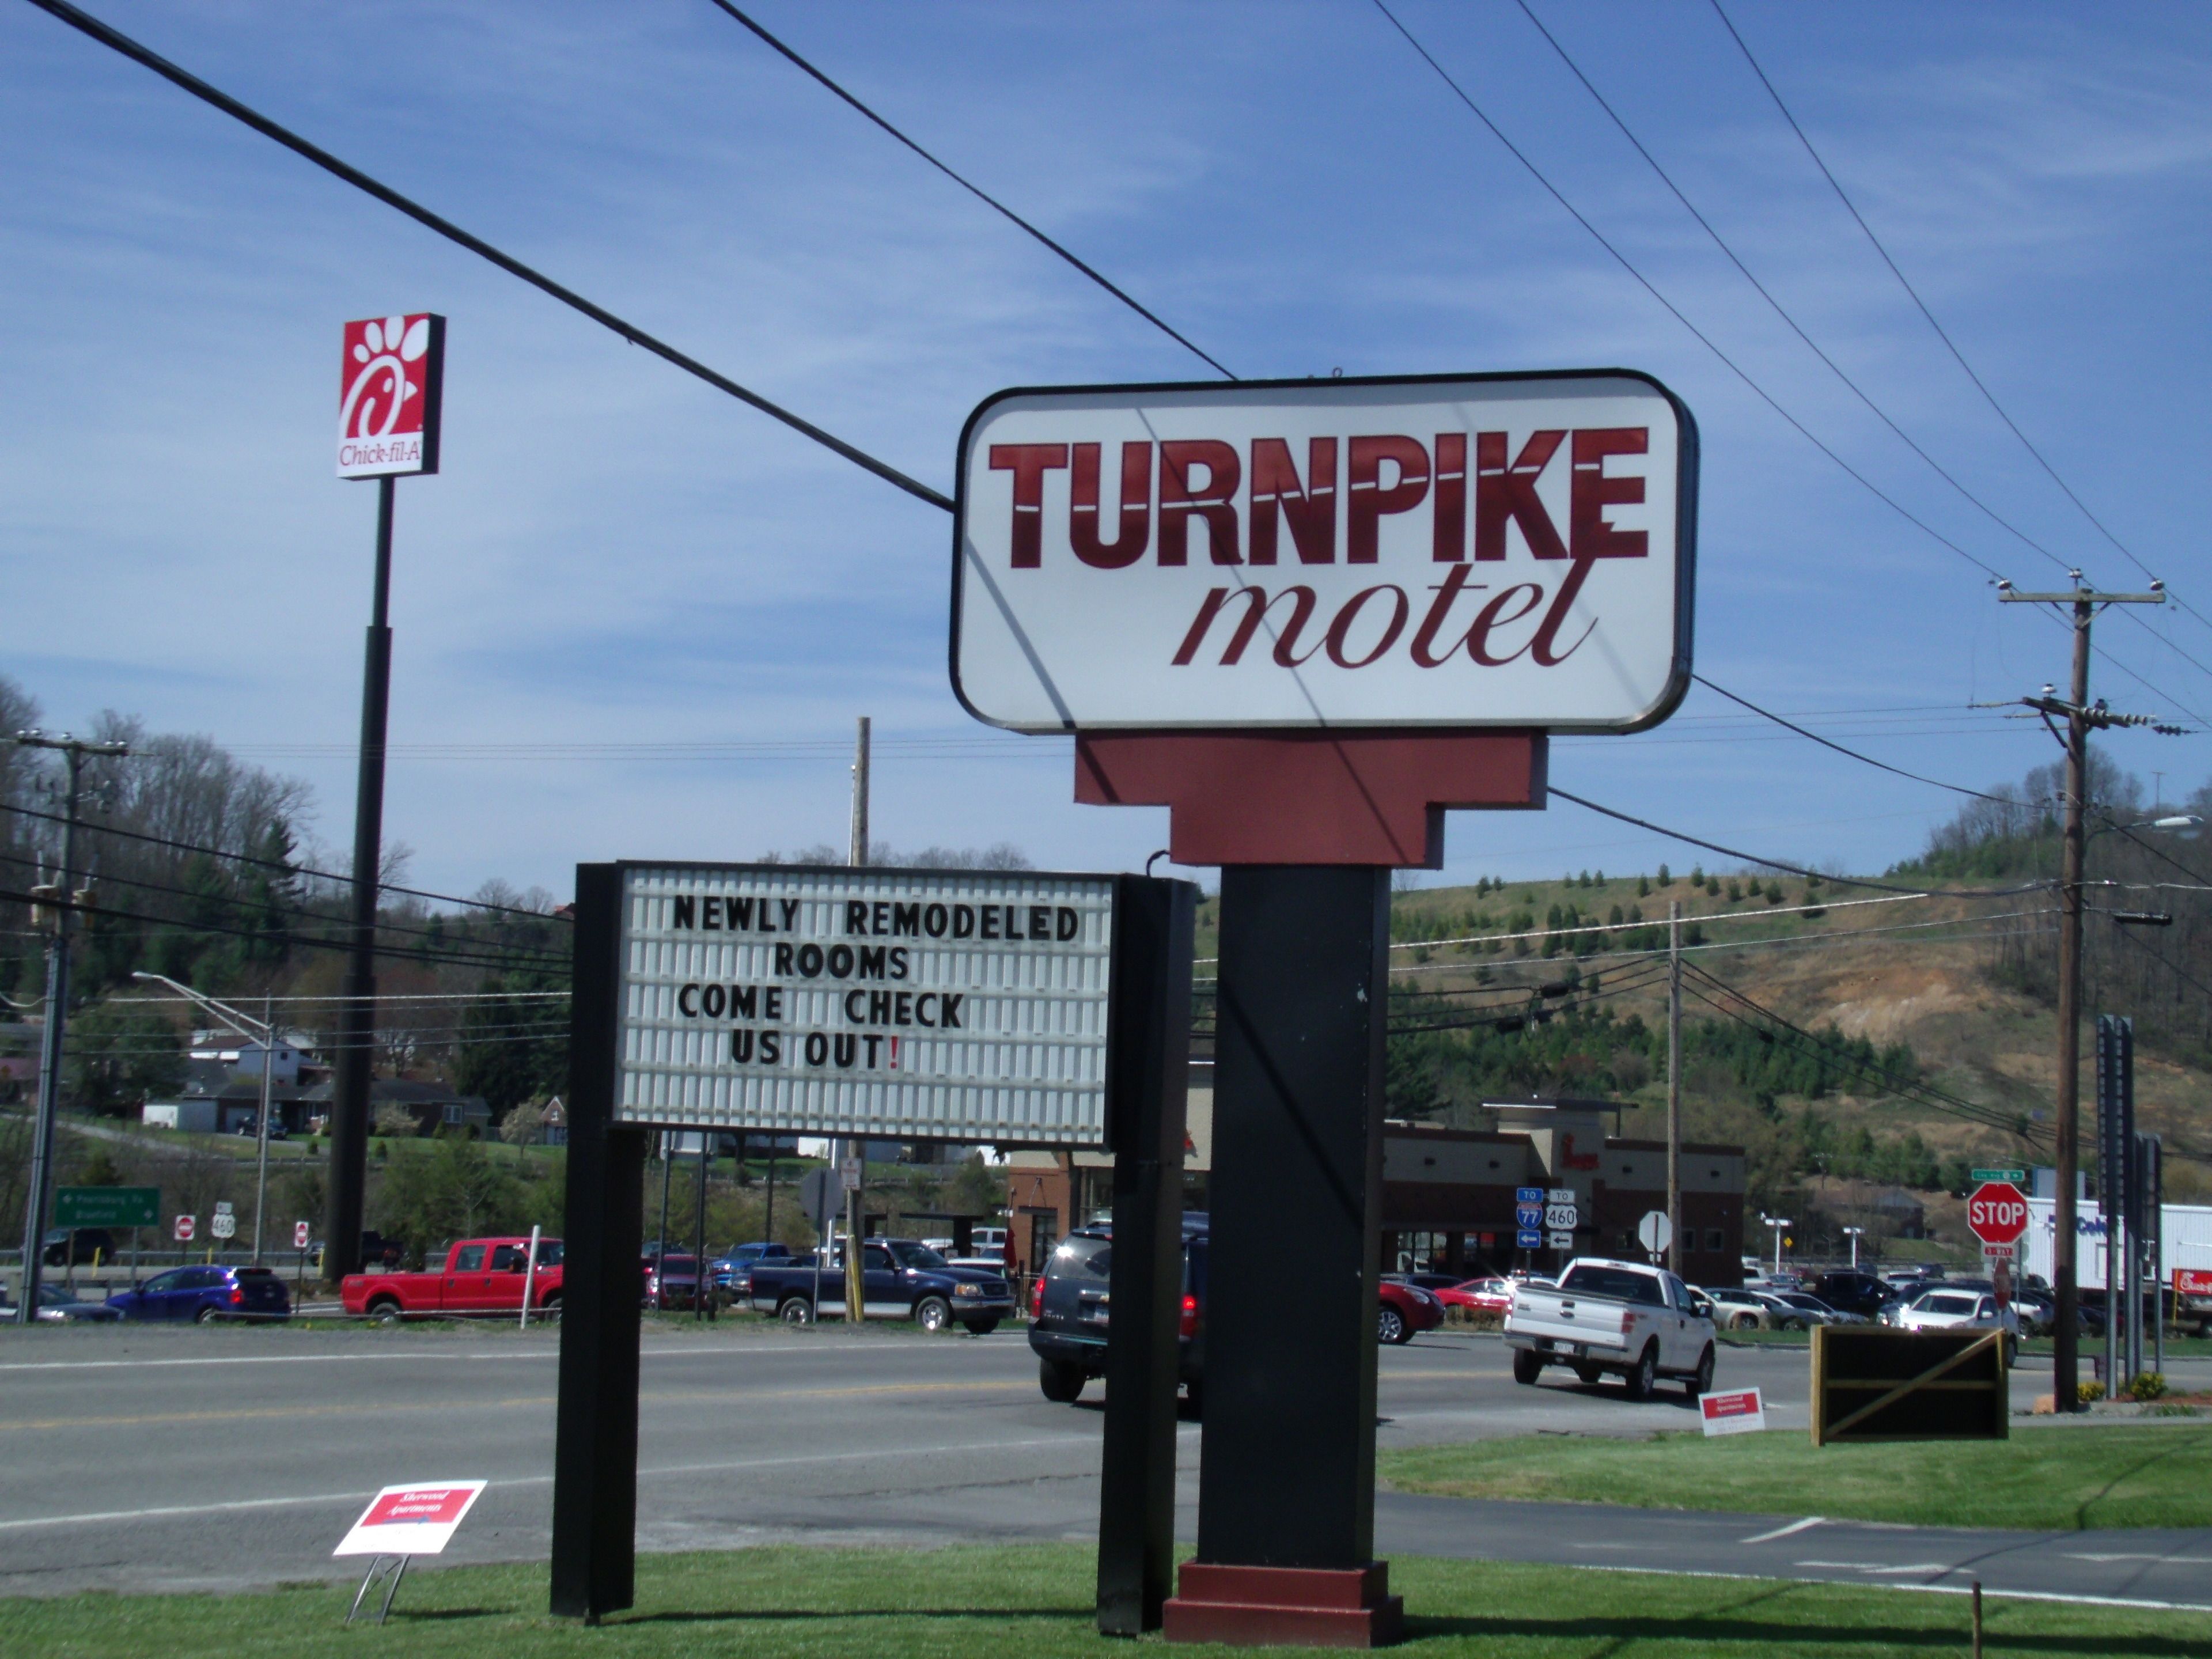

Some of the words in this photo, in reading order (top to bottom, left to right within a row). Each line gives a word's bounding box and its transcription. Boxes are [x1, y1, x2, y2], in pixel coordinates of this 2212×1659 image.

[340, 441, 421, 466] Chick-fil-A
[988, 426, 1649, 569] TURNPIKE
[1171, 522, 1615, 669] motel
[674, 895, 800, 932] NEWLY
[846, 899, 1078, 942] REMODELED
[774, 941, 908, 980] ROOMS
[678, 983, 783, 1020] COME
[844, 988, 964, 1028] CHECK
[732, 1029, 781, 1065] US
[805, 1031, 899, 1070] OUT!
[1524, 1191, 1536, 1200] TO
[1556, 1192, 1569, 1200] TO
[213, 1218, 234, 1233] 460
[1521, 1210, 1539, 1224] 77
[1548, 1210, 1575, 1224] 460
[1972, 1200, 2025, 1226] STOP
[399, 1490, 451, 1503] Sherwood
[387, 1503, 443, 1517] Apartments
